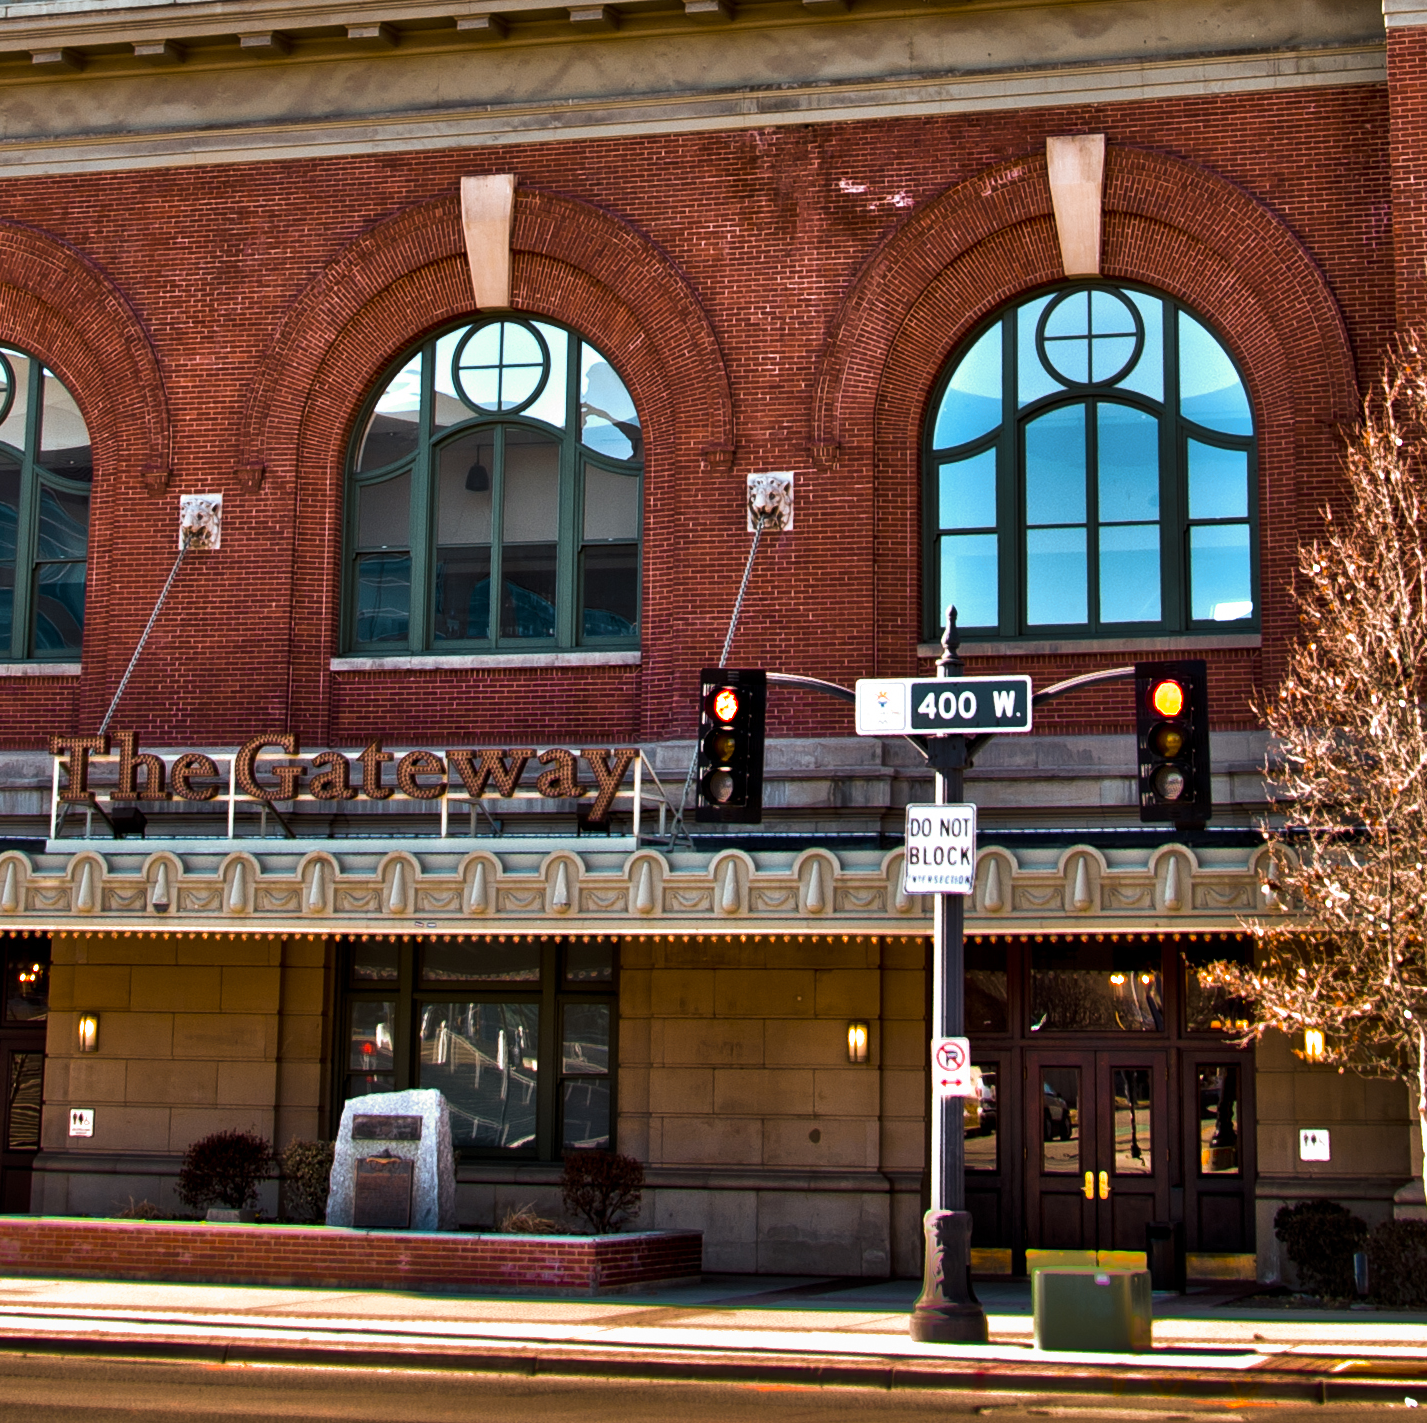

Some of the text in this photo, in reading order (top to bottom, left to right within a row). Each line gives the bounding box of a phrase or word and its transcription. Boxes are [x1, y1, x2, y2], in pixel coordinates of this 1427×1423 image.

[918, 690, 1021, 720] 400 W.
[49, 731, 641, 823] The Gateway
[910, 817, 971, 838] DO NOT
[909, 846, 971, 866] BLOCK
